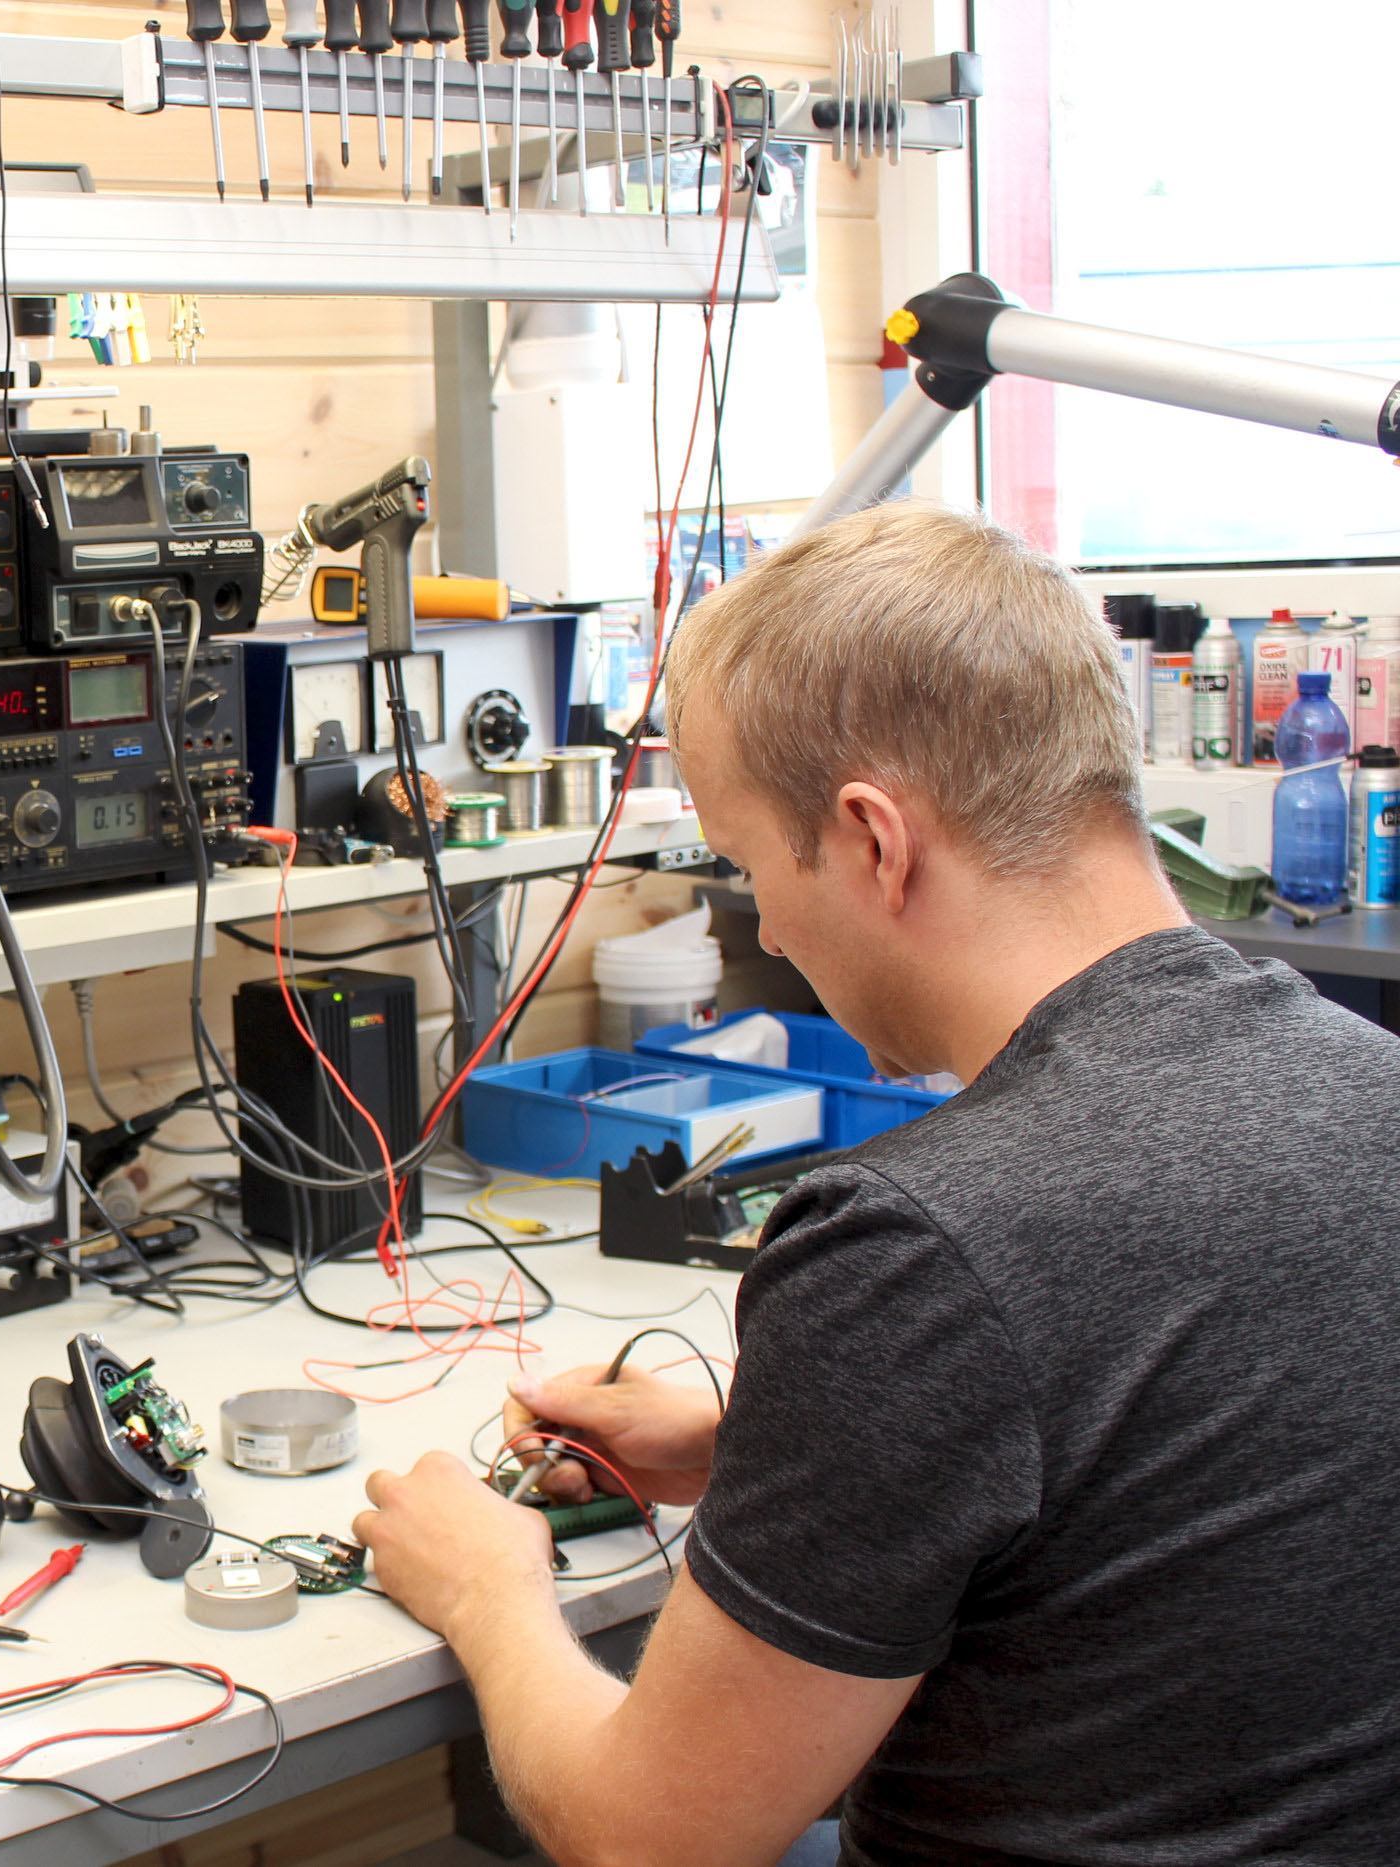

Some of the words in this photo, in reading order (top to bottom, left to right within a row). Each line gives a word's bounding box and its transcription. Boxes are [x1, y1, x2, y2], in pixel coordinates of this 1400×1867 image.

[1259, 662, 1288, 671] OXIDE
[1259, 671, 1288, 681] CLEAN
[94, 802, 137, 830] 0.15
